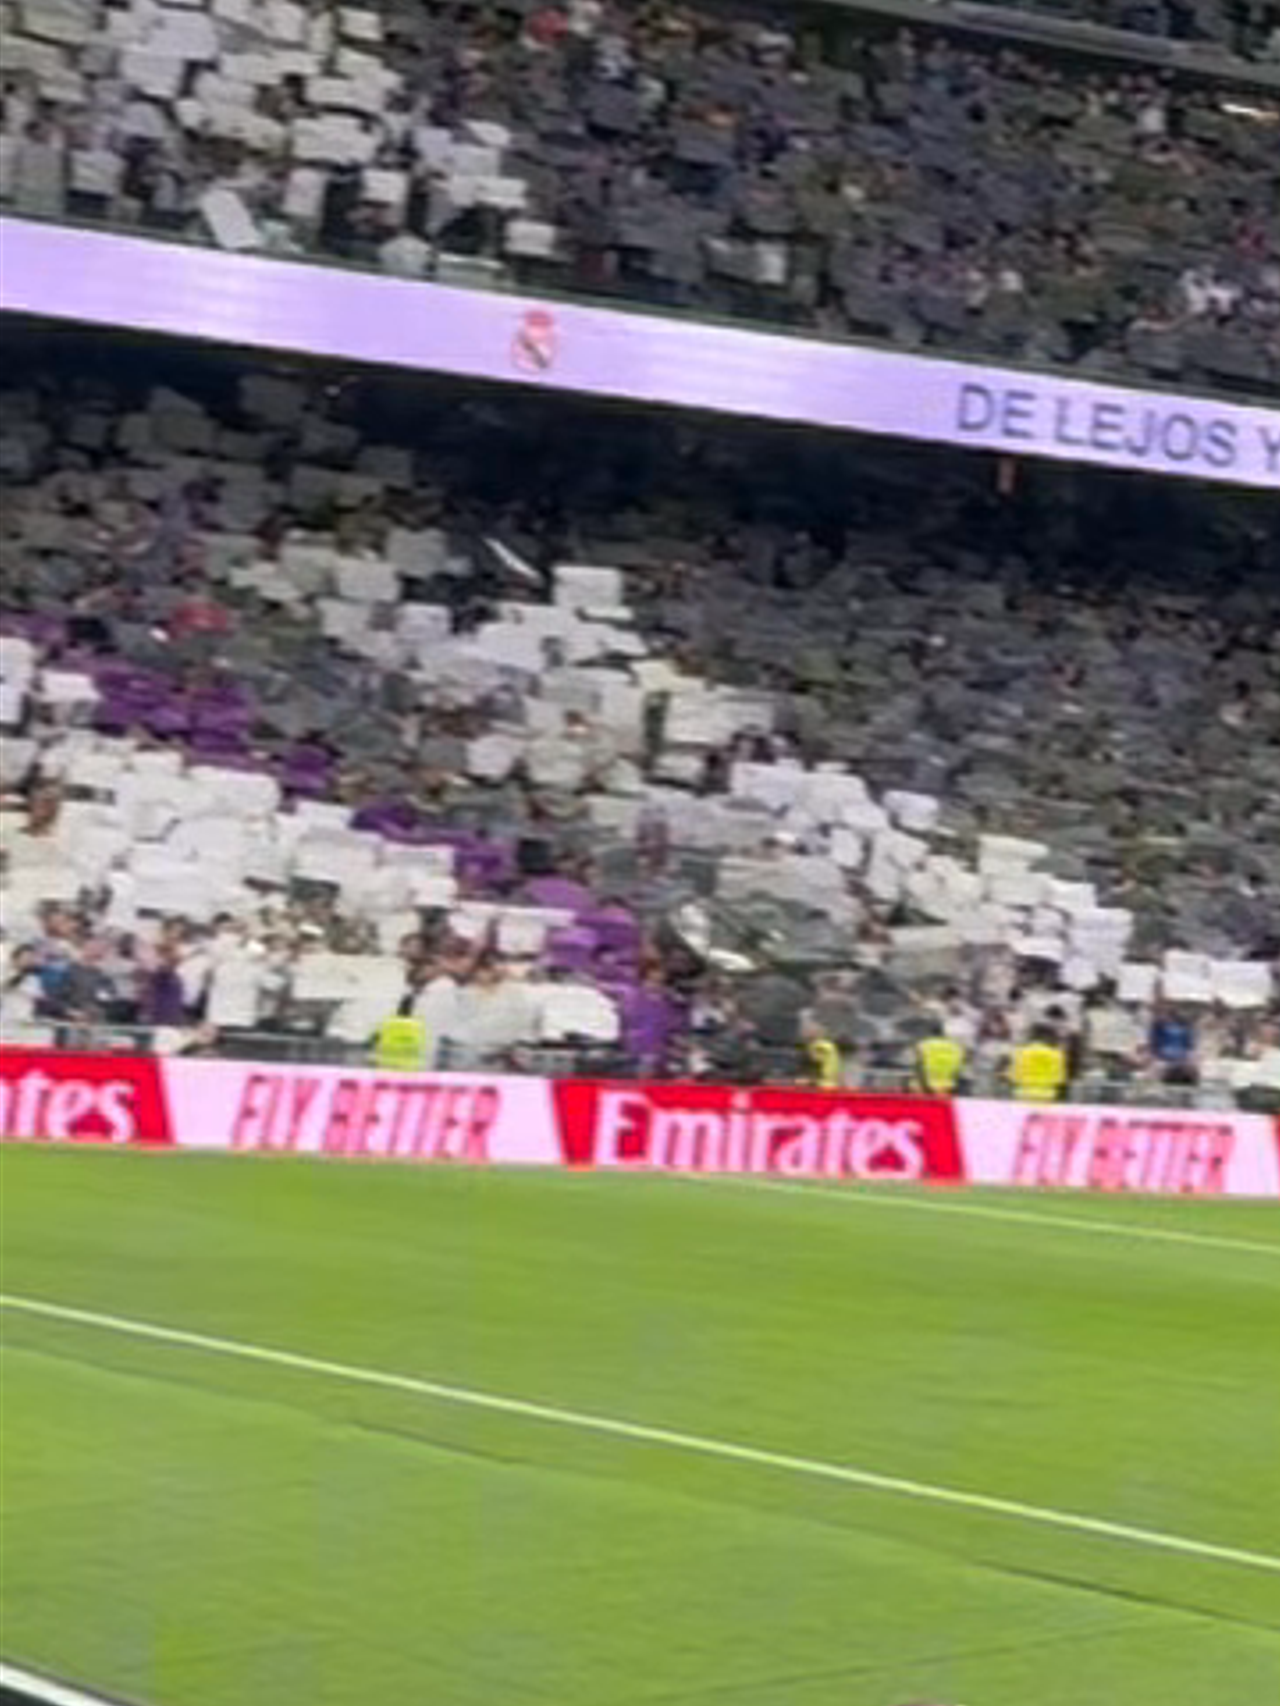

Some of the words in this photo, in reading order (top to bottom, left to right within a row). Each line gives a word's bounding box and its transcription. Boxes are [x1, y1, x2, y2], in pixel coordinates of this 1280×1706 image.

[957, 383, 1035, 439] DE
[1053, 397, 1237, 468] LEJOS
[0, 1068, 135, 1143] tes
[232, 1074, 322, 1150] FLY
[322, 1079, 500, 1161] BETTER
[596, 1089, 926, 1180] Emirates
